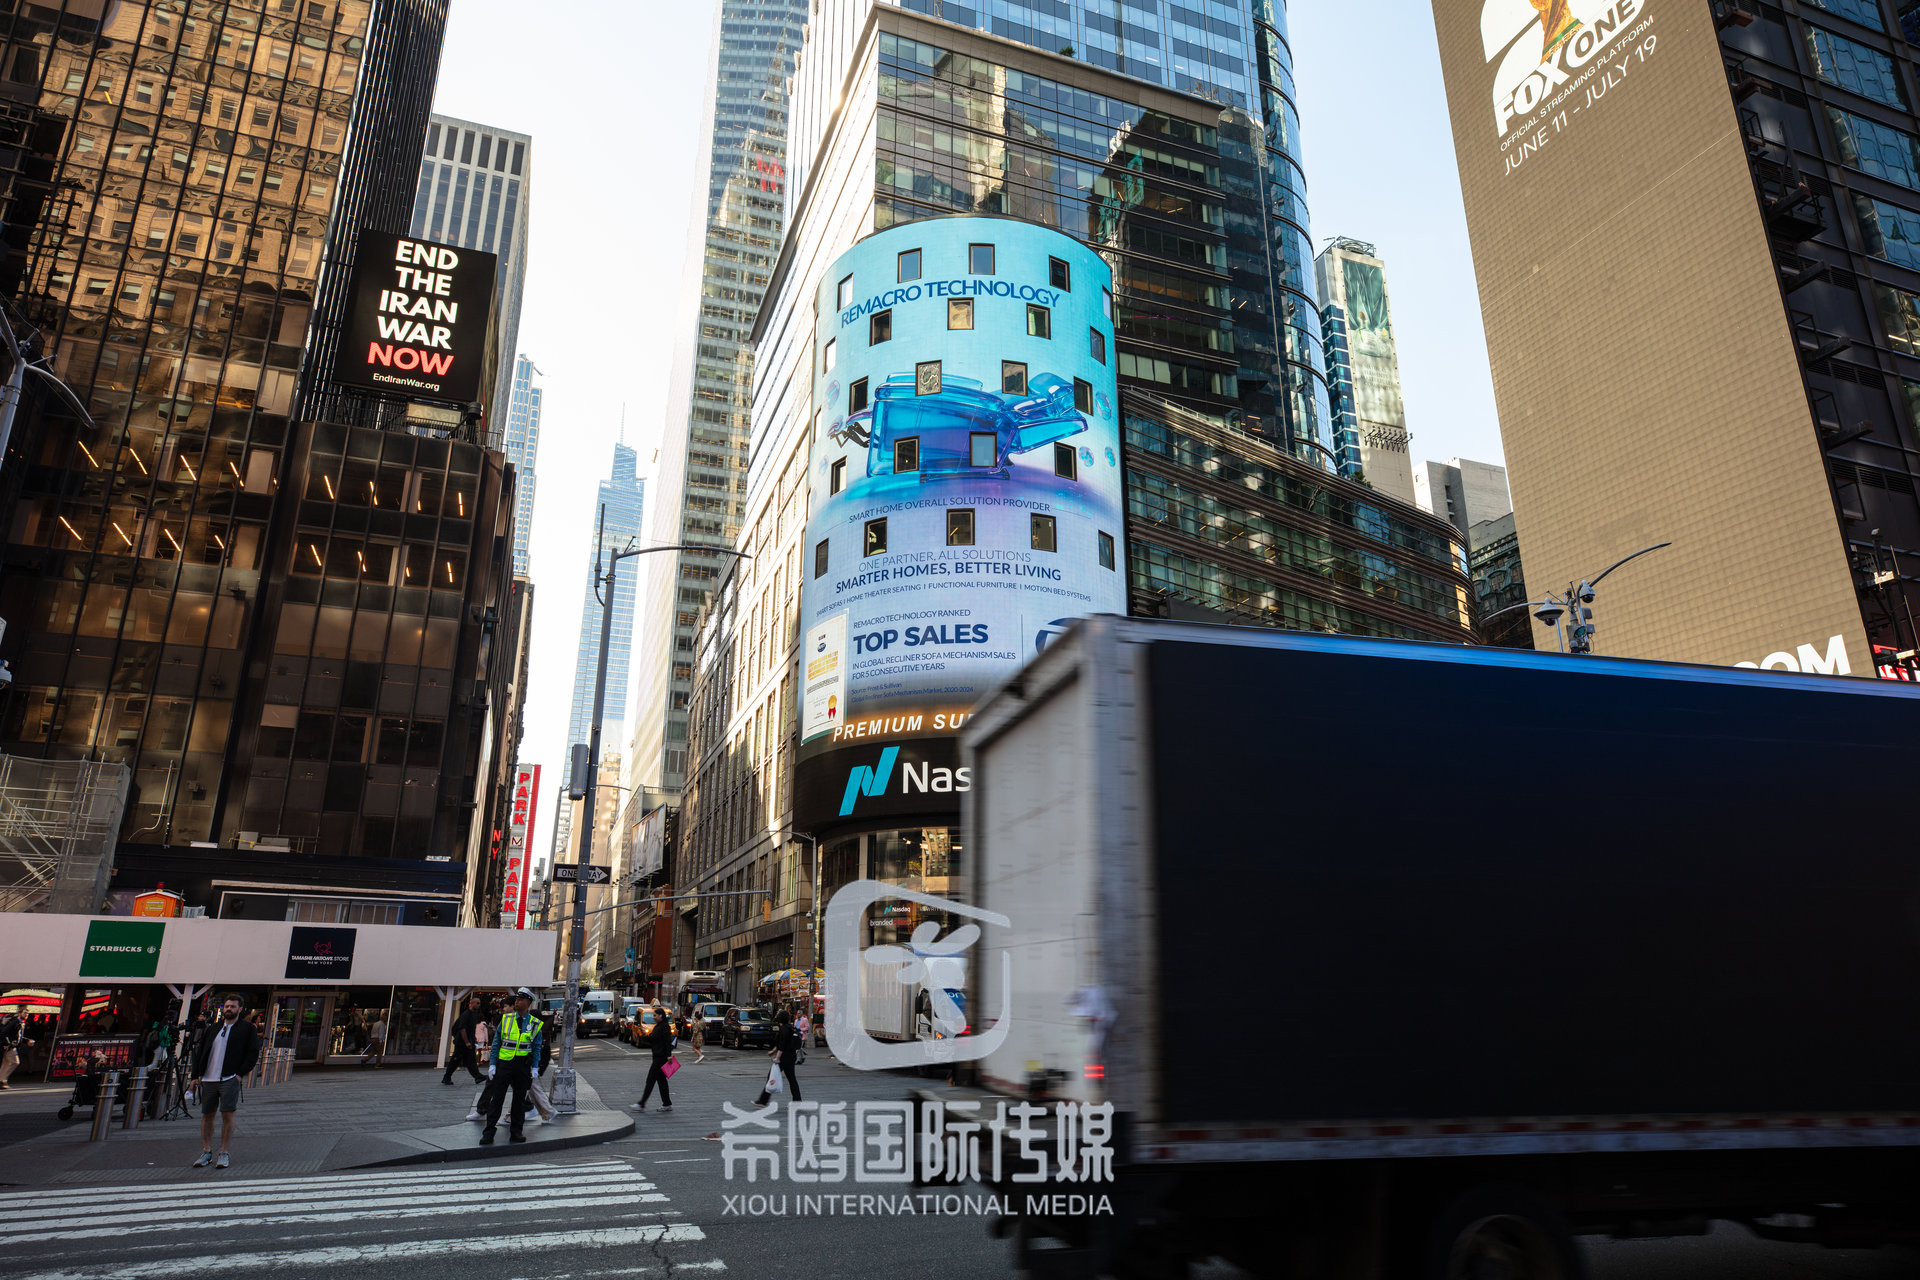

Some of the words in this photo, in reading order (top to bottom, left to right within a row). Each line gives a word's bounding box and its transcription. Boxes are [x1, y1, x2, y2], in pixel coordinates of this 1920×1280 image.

[1494, 45, 1570, 138] FOX
[1574, 0, 1637, 59] ONE
[1500, 116, 1539, 152] OFFICIAL
[1539, 66, 1596, 118] STREAMING
[1597, 15, 1654, 70] PLATFORM
[1505, 126, 1549, 176] JUNE
[1552, 110, 1568, 133] 11
[1586, 55, 1629, 109] JULY
[1634, 34, 1657, 63] 19
[395, 240, 459, 270] END
[395, 266, 452, 297] THE
[379, 290, 458, 324] IRAN
[841, 285, 922, 328] REMACRO
[924, 280, 1060, 307] TECHNOLOGY
[377, 315, 452, 350] WAR
[367, 342, 454, 376] NOW
[373, 373, 440, 392] EndIranWar.org
[849, 508, 875, 523] SMART
[875, 503, 903, 517] HOME
[905, 498, 948, 510] OVERALL
[950, 497, 1000, 506] SOLUTION
[1003, 498, 1051, 512] PROVIDER
[859, 558, 880, 572] ONE
[938, 550, 960, 560] ALL
[962, 550, 1031, 562] SOLUTIONS
[836, 569, 889, 594] SMARTER
[893, 562, 951, 579] HOMES,
[955, 561, 1011, 574] BETTER
[1015, 563, 1062, 581] LIVING
[846, 594, 864, 607] HOME
[864, 587, 891, 599] THEATER
[892, 583, 921, 594] SEATING
[928, 581, 975, 589] FUNCTIONAL
[976, 581, 1017, 590] FURNITURE
[1024, 584, 1052, 594] MOTION
[1053, 587, 1066, 597] BED
[1067, 590, 1091, 602] SYSTEMS
[853, 616, 885, 629] REMACRO
[886, 611, 937, 622] TECHNOLOGY
[938, 609, 971, 617] RANKED
[853, 629, 898, 654] TOP
[904, 623, 989, 647] SALES
[852, 662, 860, 670] IN
[860, 657, 885, 669] GLOBAL
[886, 653, 920, 663] RECLINER
[921, 652, 942, 661] SOFA
[943, 651, 993, 659] MECHANISM
[993, 651, 1016, 660] SALES
[852, 671, 865, 681] FOR
[865, 670, 870, 678] 5
[870, 664, 920, 676] CONSECUTIVE
[920, 662, 945, 671] YEARS
[833, 715, 923, 743] PREMIUM
[933, 713, 975, 730] SU
[514, 772, 531, 825] PARK
[503, 857, 521, 913] PARK
[561, 869, 577, 878] ONE
[89, 945, 142, 953] STARBUCKS
